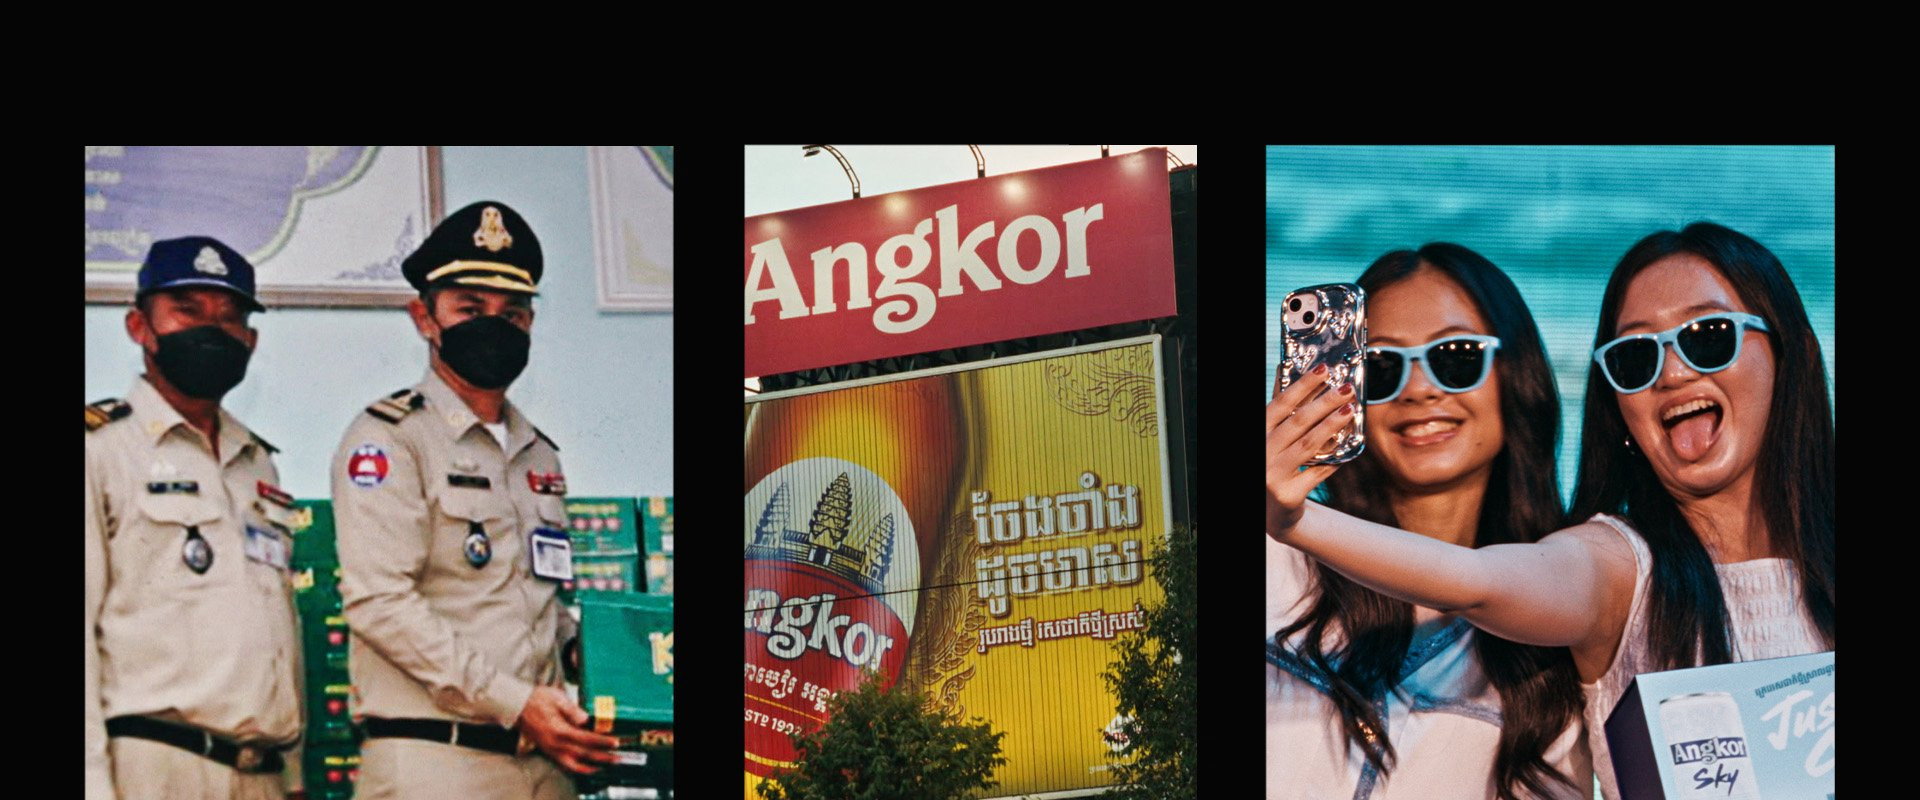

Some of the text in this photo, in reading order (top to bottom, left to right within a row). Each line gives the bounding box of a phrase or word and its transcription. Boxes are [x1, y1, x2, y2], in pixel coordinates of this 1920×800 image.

[744, 203, 1104, 334] Angkor
[1674, 737, 1746, 765] Angkor
[1693, 763, 1739, 797] Sky
